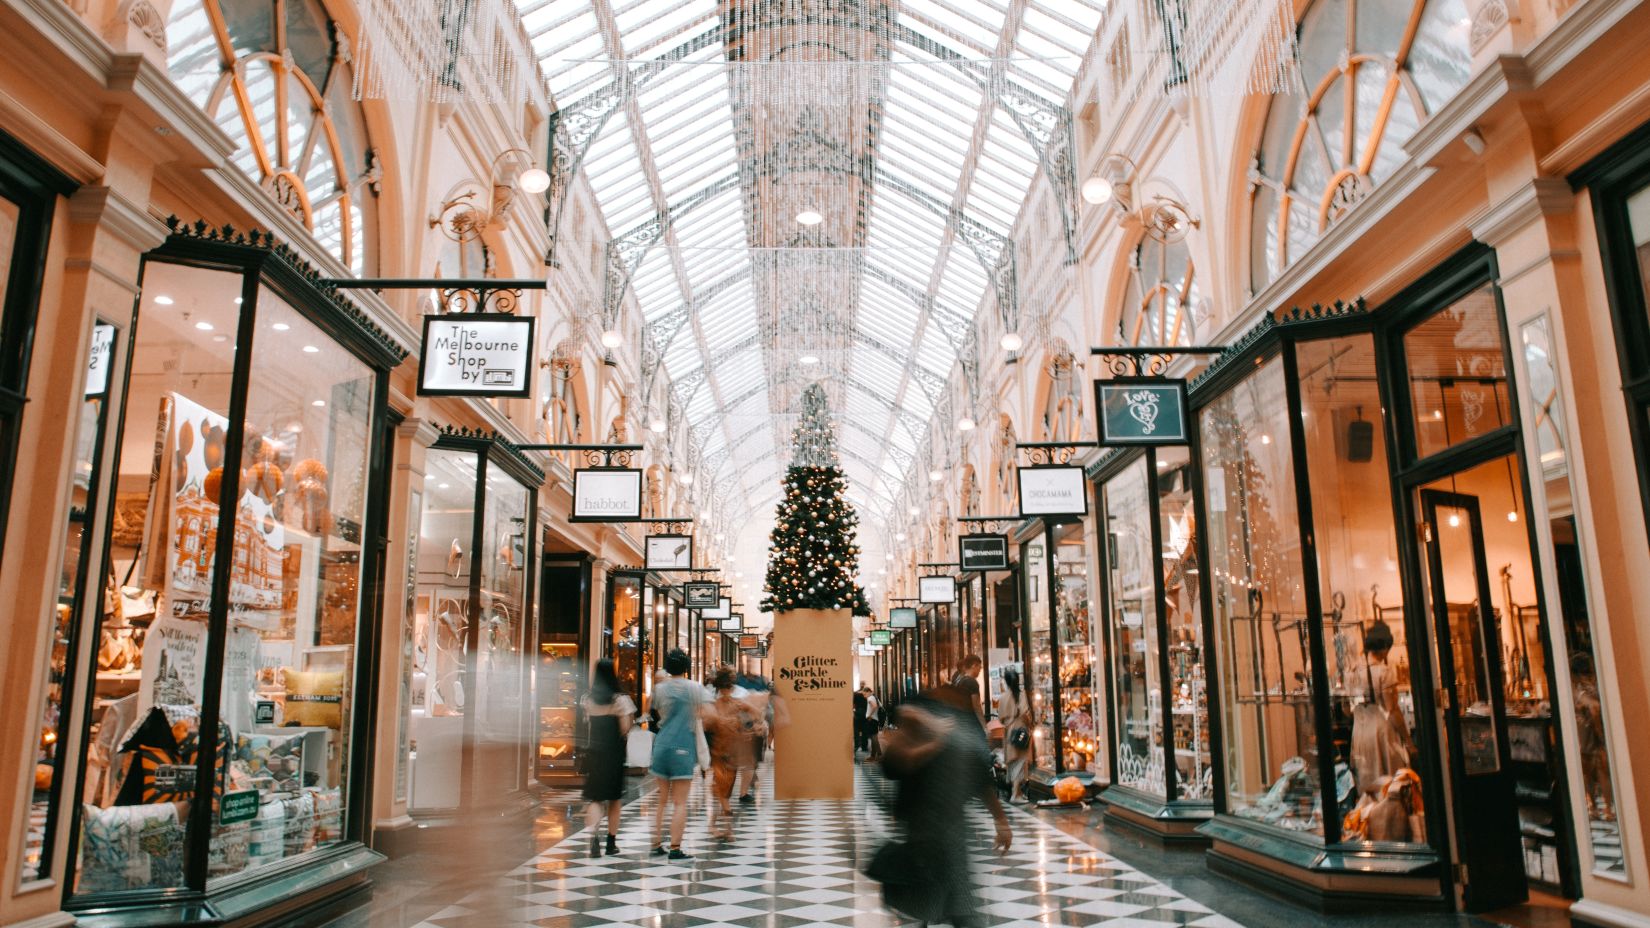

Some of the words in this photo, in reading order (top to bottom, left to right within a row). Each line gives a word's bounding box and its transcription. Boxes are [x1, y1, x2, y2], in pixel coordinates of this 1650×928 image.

[451, 325, 478, 339] The
[435, 337, 519, 352] Melbourne
[447, 352, 487, 370] Shop
[461, 370, 480, 383] by
[793, 655, 838, 669] Glitter.
[779, 667, 828, 680] Sparkle
